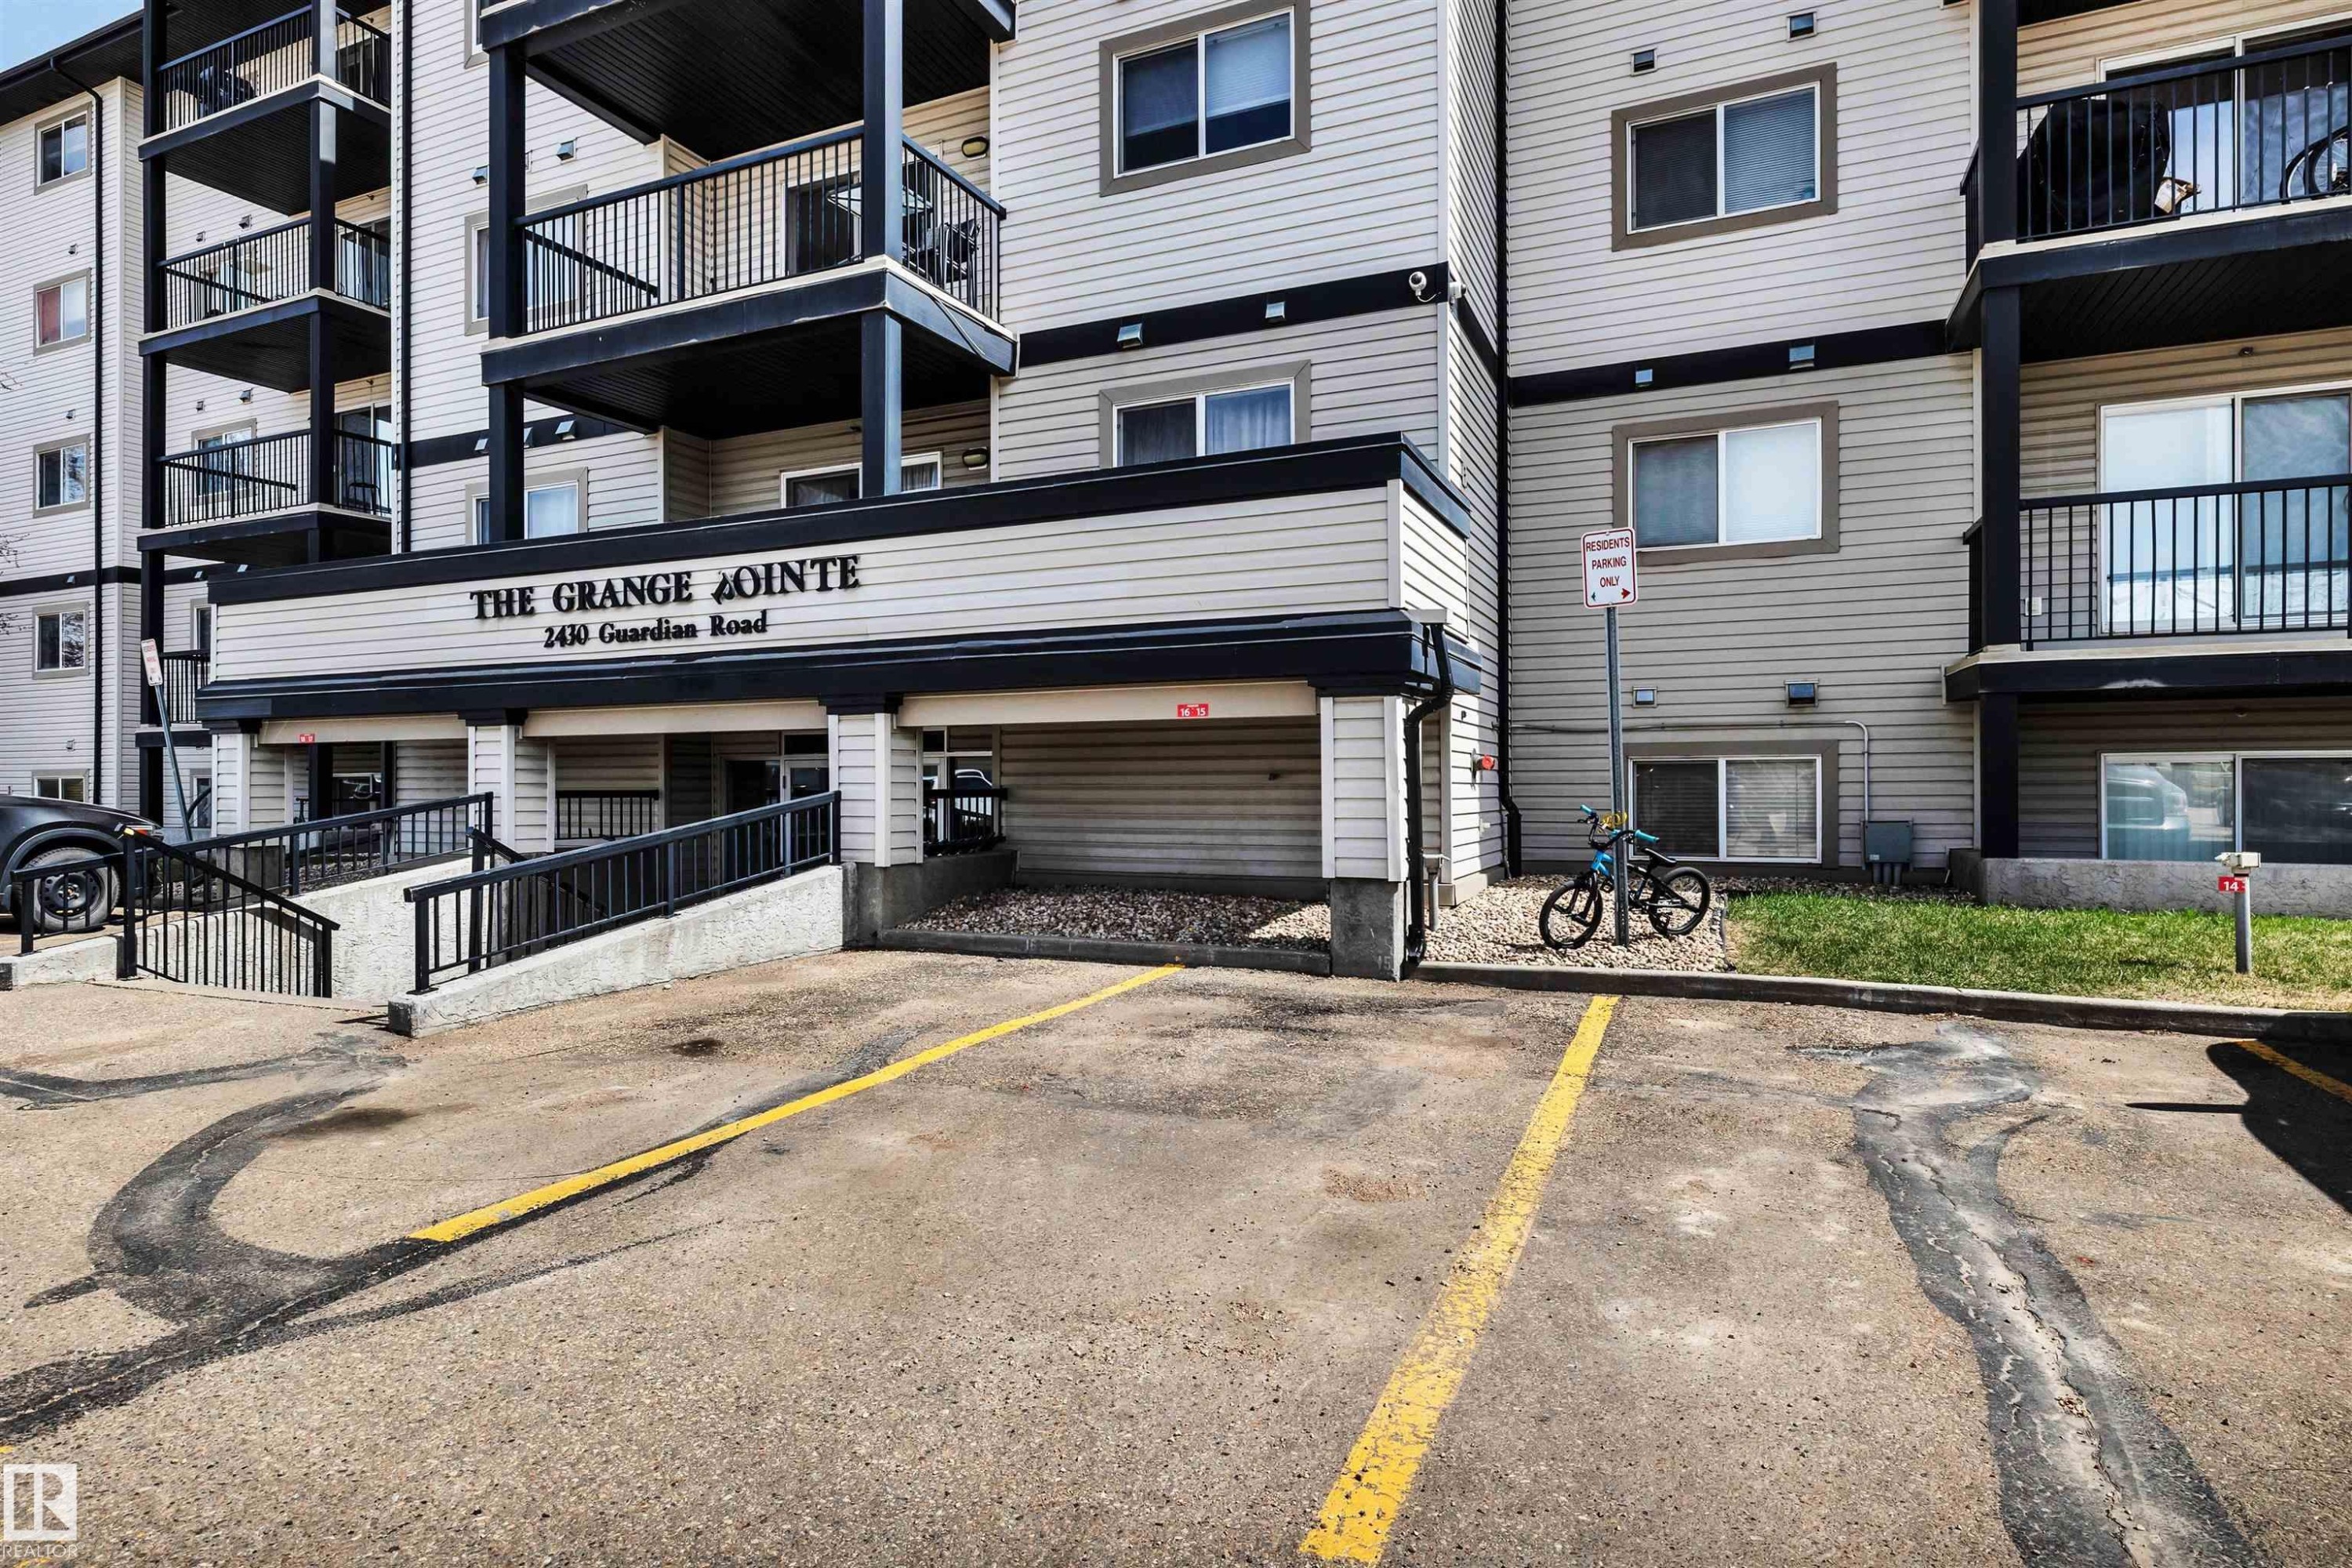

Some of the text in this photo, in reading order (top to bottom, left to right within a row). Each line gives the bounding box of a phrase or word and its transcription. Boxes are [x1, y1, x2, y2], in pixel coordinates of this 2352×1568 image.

[1586, 537, 1630, 552] RESIDENTS
[1592, 556, 1627, 570] PARKING
[1600, 575, 1620, 587] ONLY
[470, 587, 535, 619] THE
[553, 571, 693, 612] GRANGE
[543, 609, 768, 648] 2430 Guardian Road
[1180, 707, 1206, 717] 16 15
[2223, 881, 2238, 891] 14
